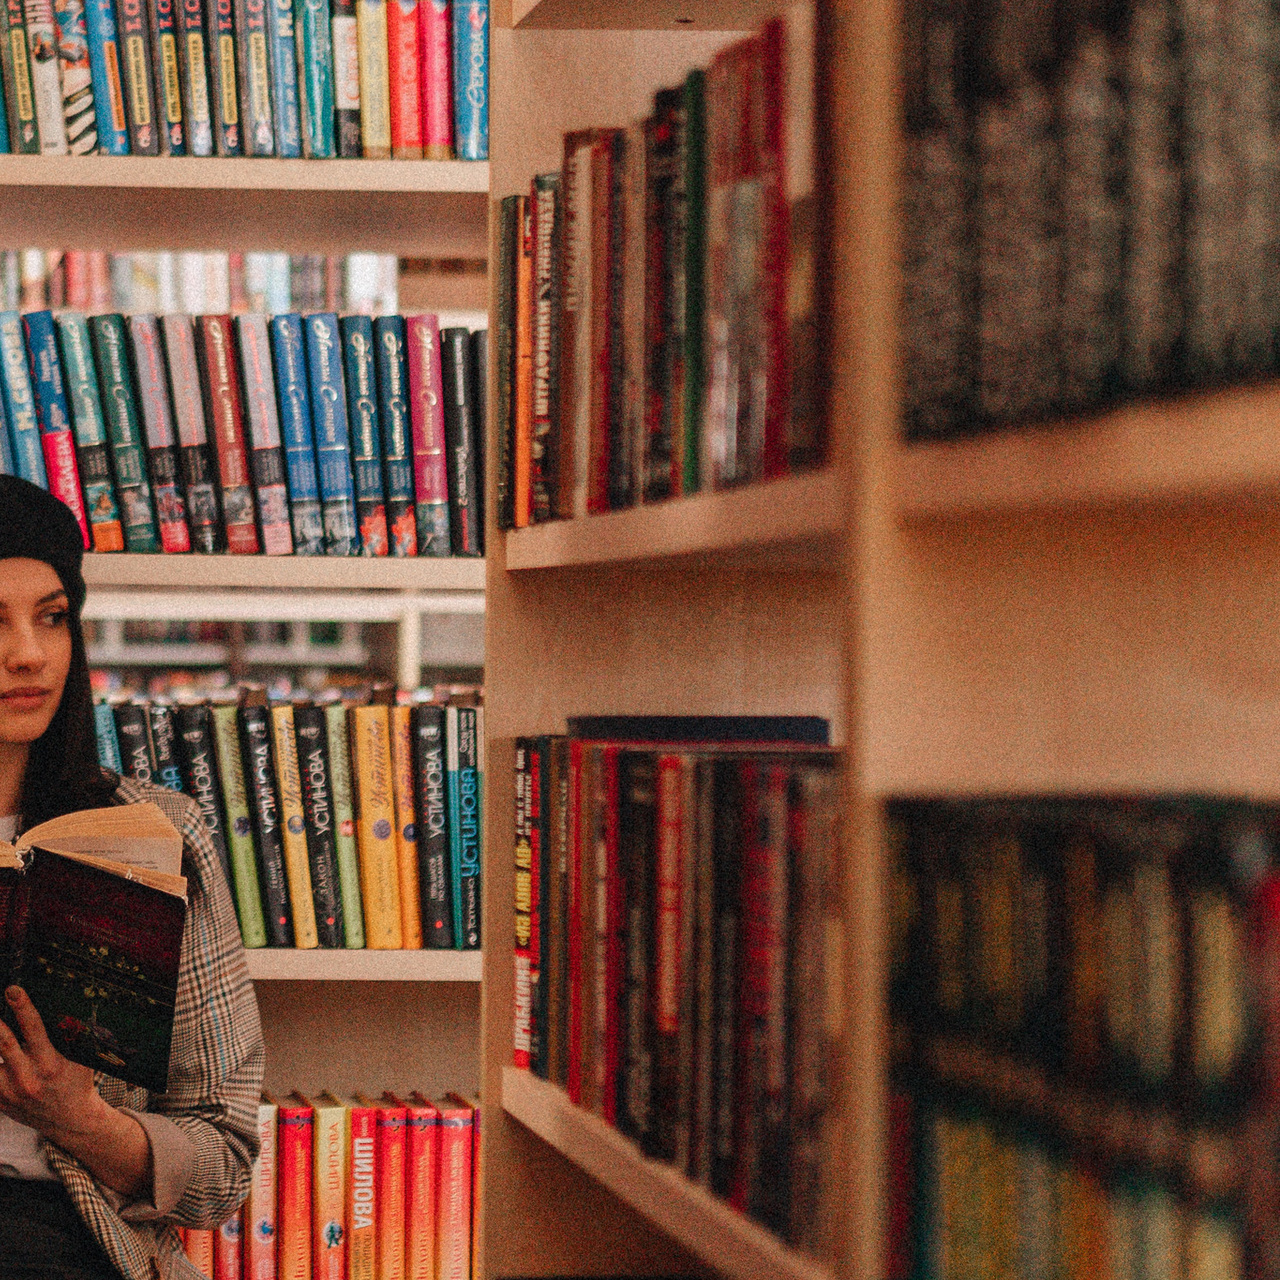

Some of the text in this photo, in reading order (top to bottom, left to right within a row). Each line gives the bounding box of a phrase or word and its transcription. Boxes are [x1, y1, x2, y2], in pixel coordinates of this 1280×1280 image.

[308, 749, 331, 836] УСТИНОВА
[426, 749, 445, 838] УСТИНОВА
[460, 767, 480, 877] УСТИНОВА
[354, 1138, 373, 1229] ШИЛОВА
